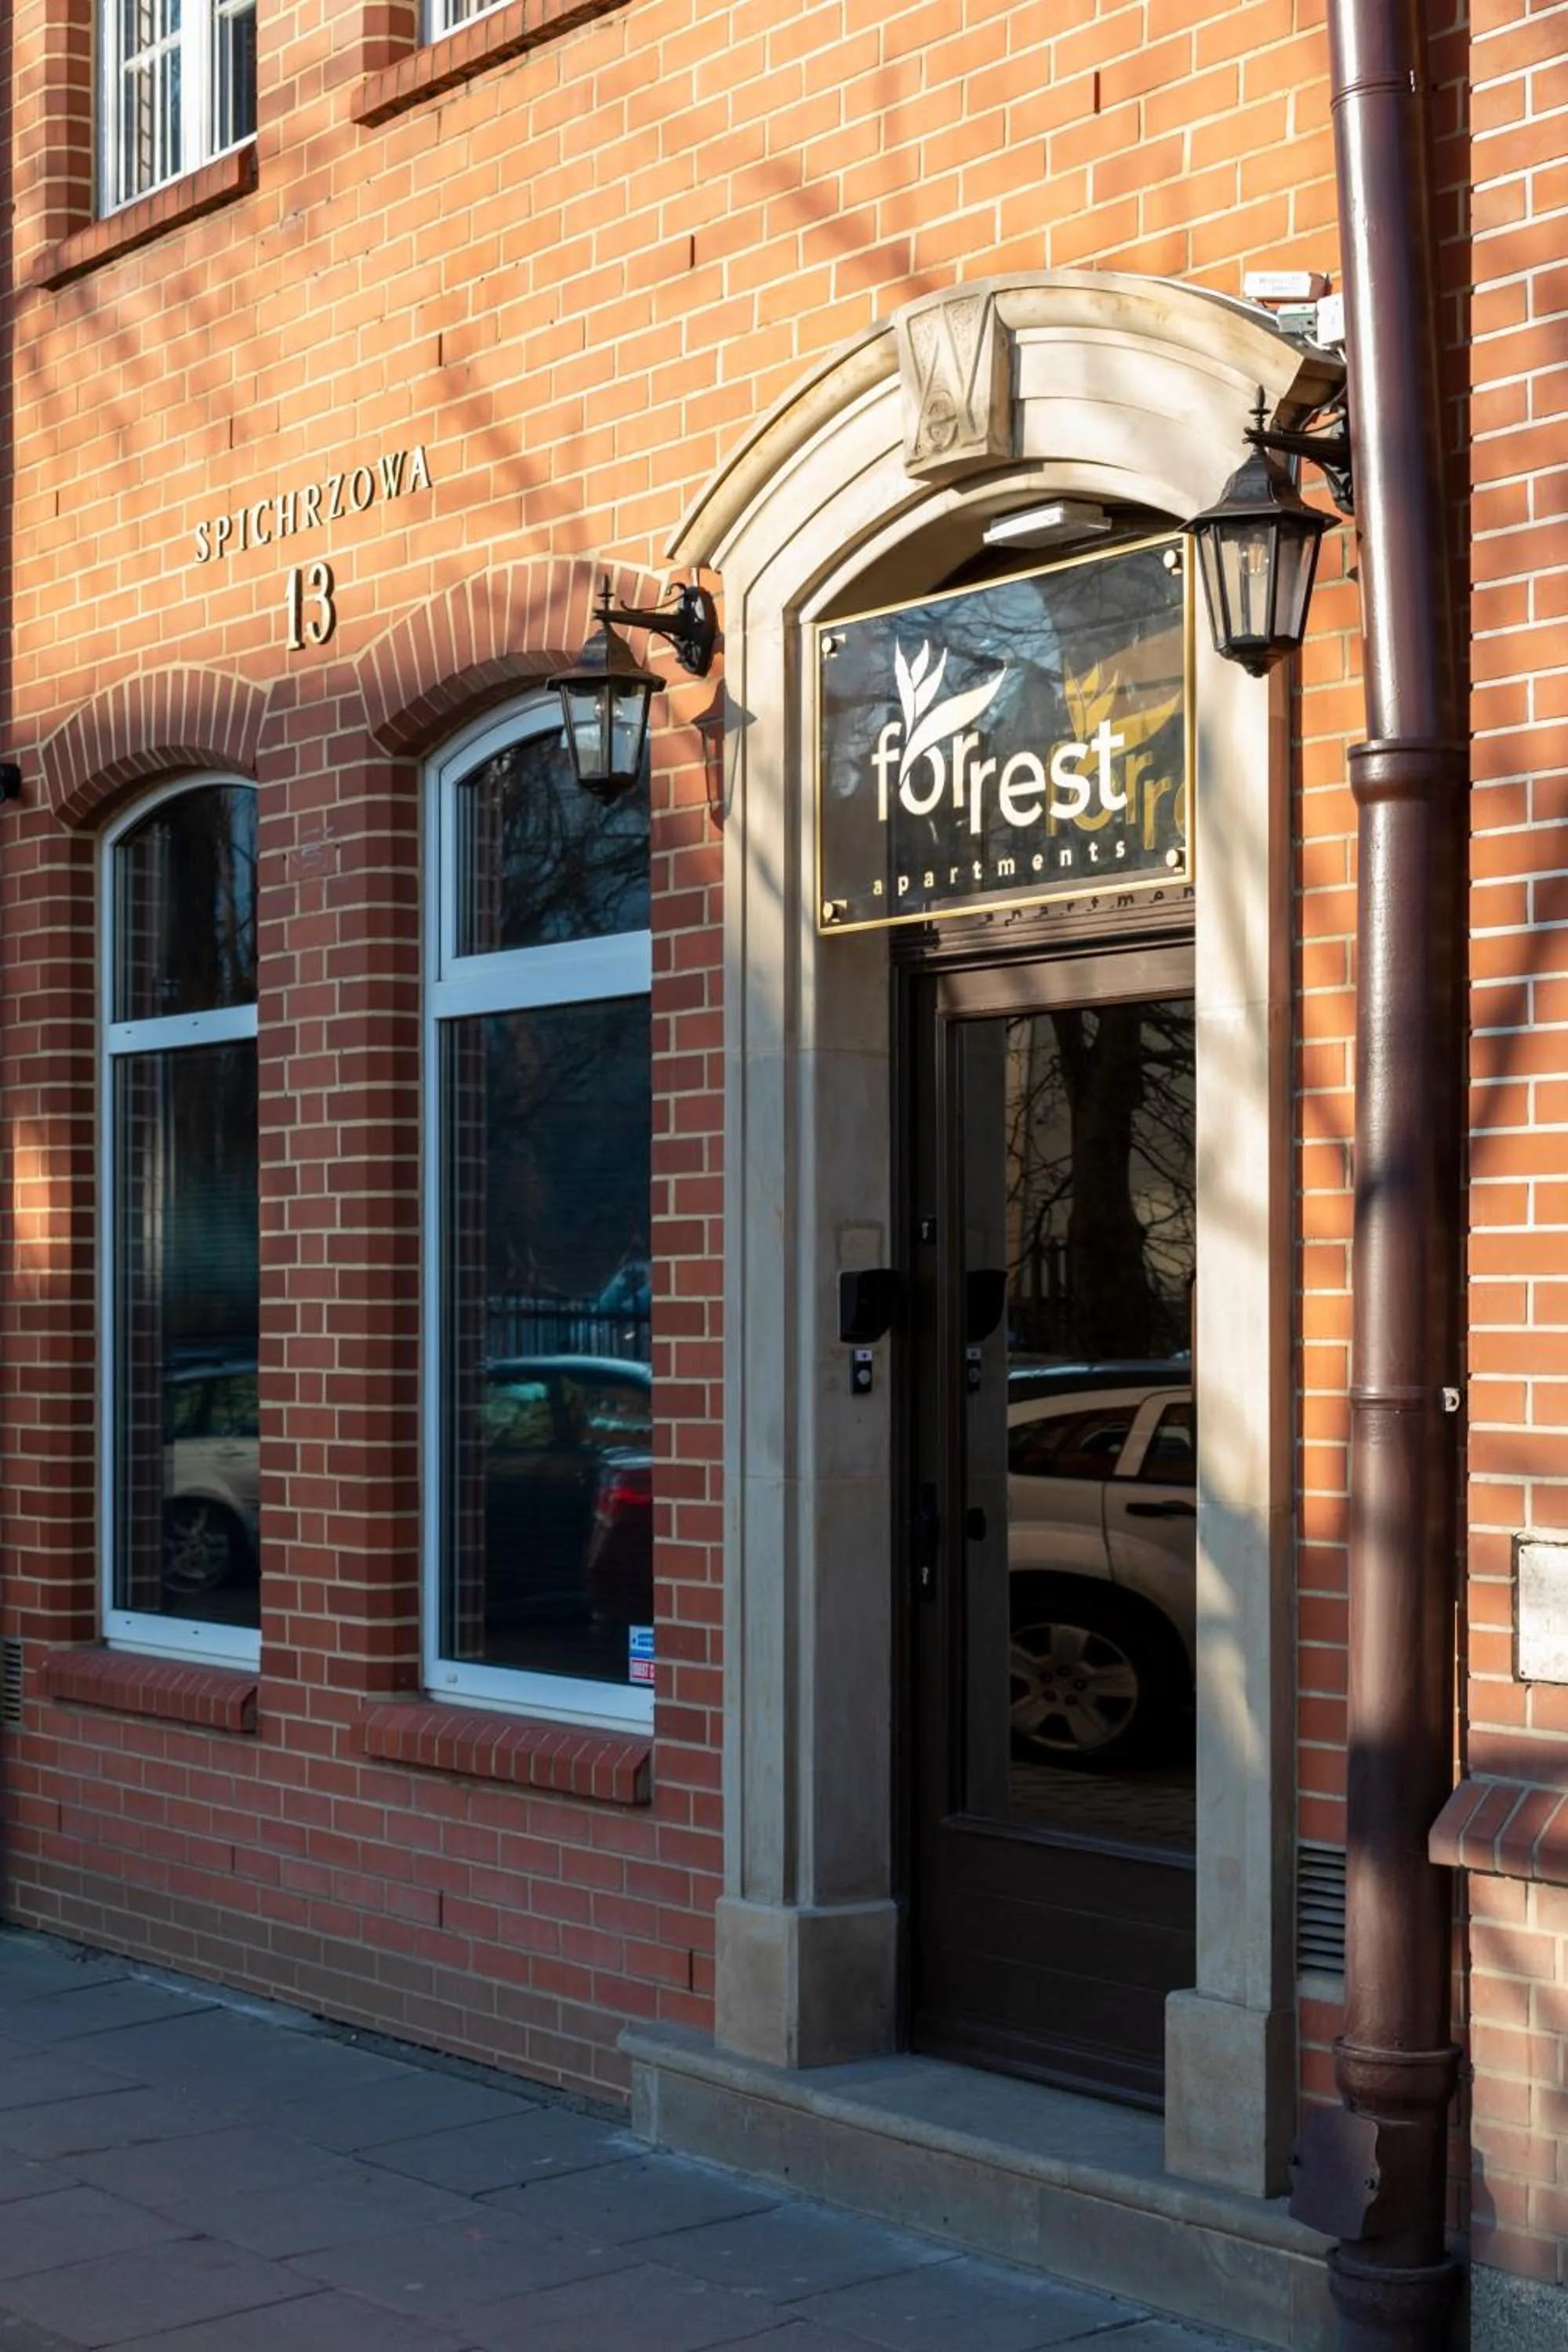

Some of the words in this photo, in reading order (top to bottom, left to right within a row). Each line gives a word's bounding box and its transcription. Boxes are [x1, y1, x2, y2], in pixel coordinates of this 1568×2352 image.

[194, 445, 432, 563] SPICHRZOWA
[285, 562, 336, 651] 13
[871, 720, 1127, 834] forrest
[873, 839, 1126, 896] apartments
